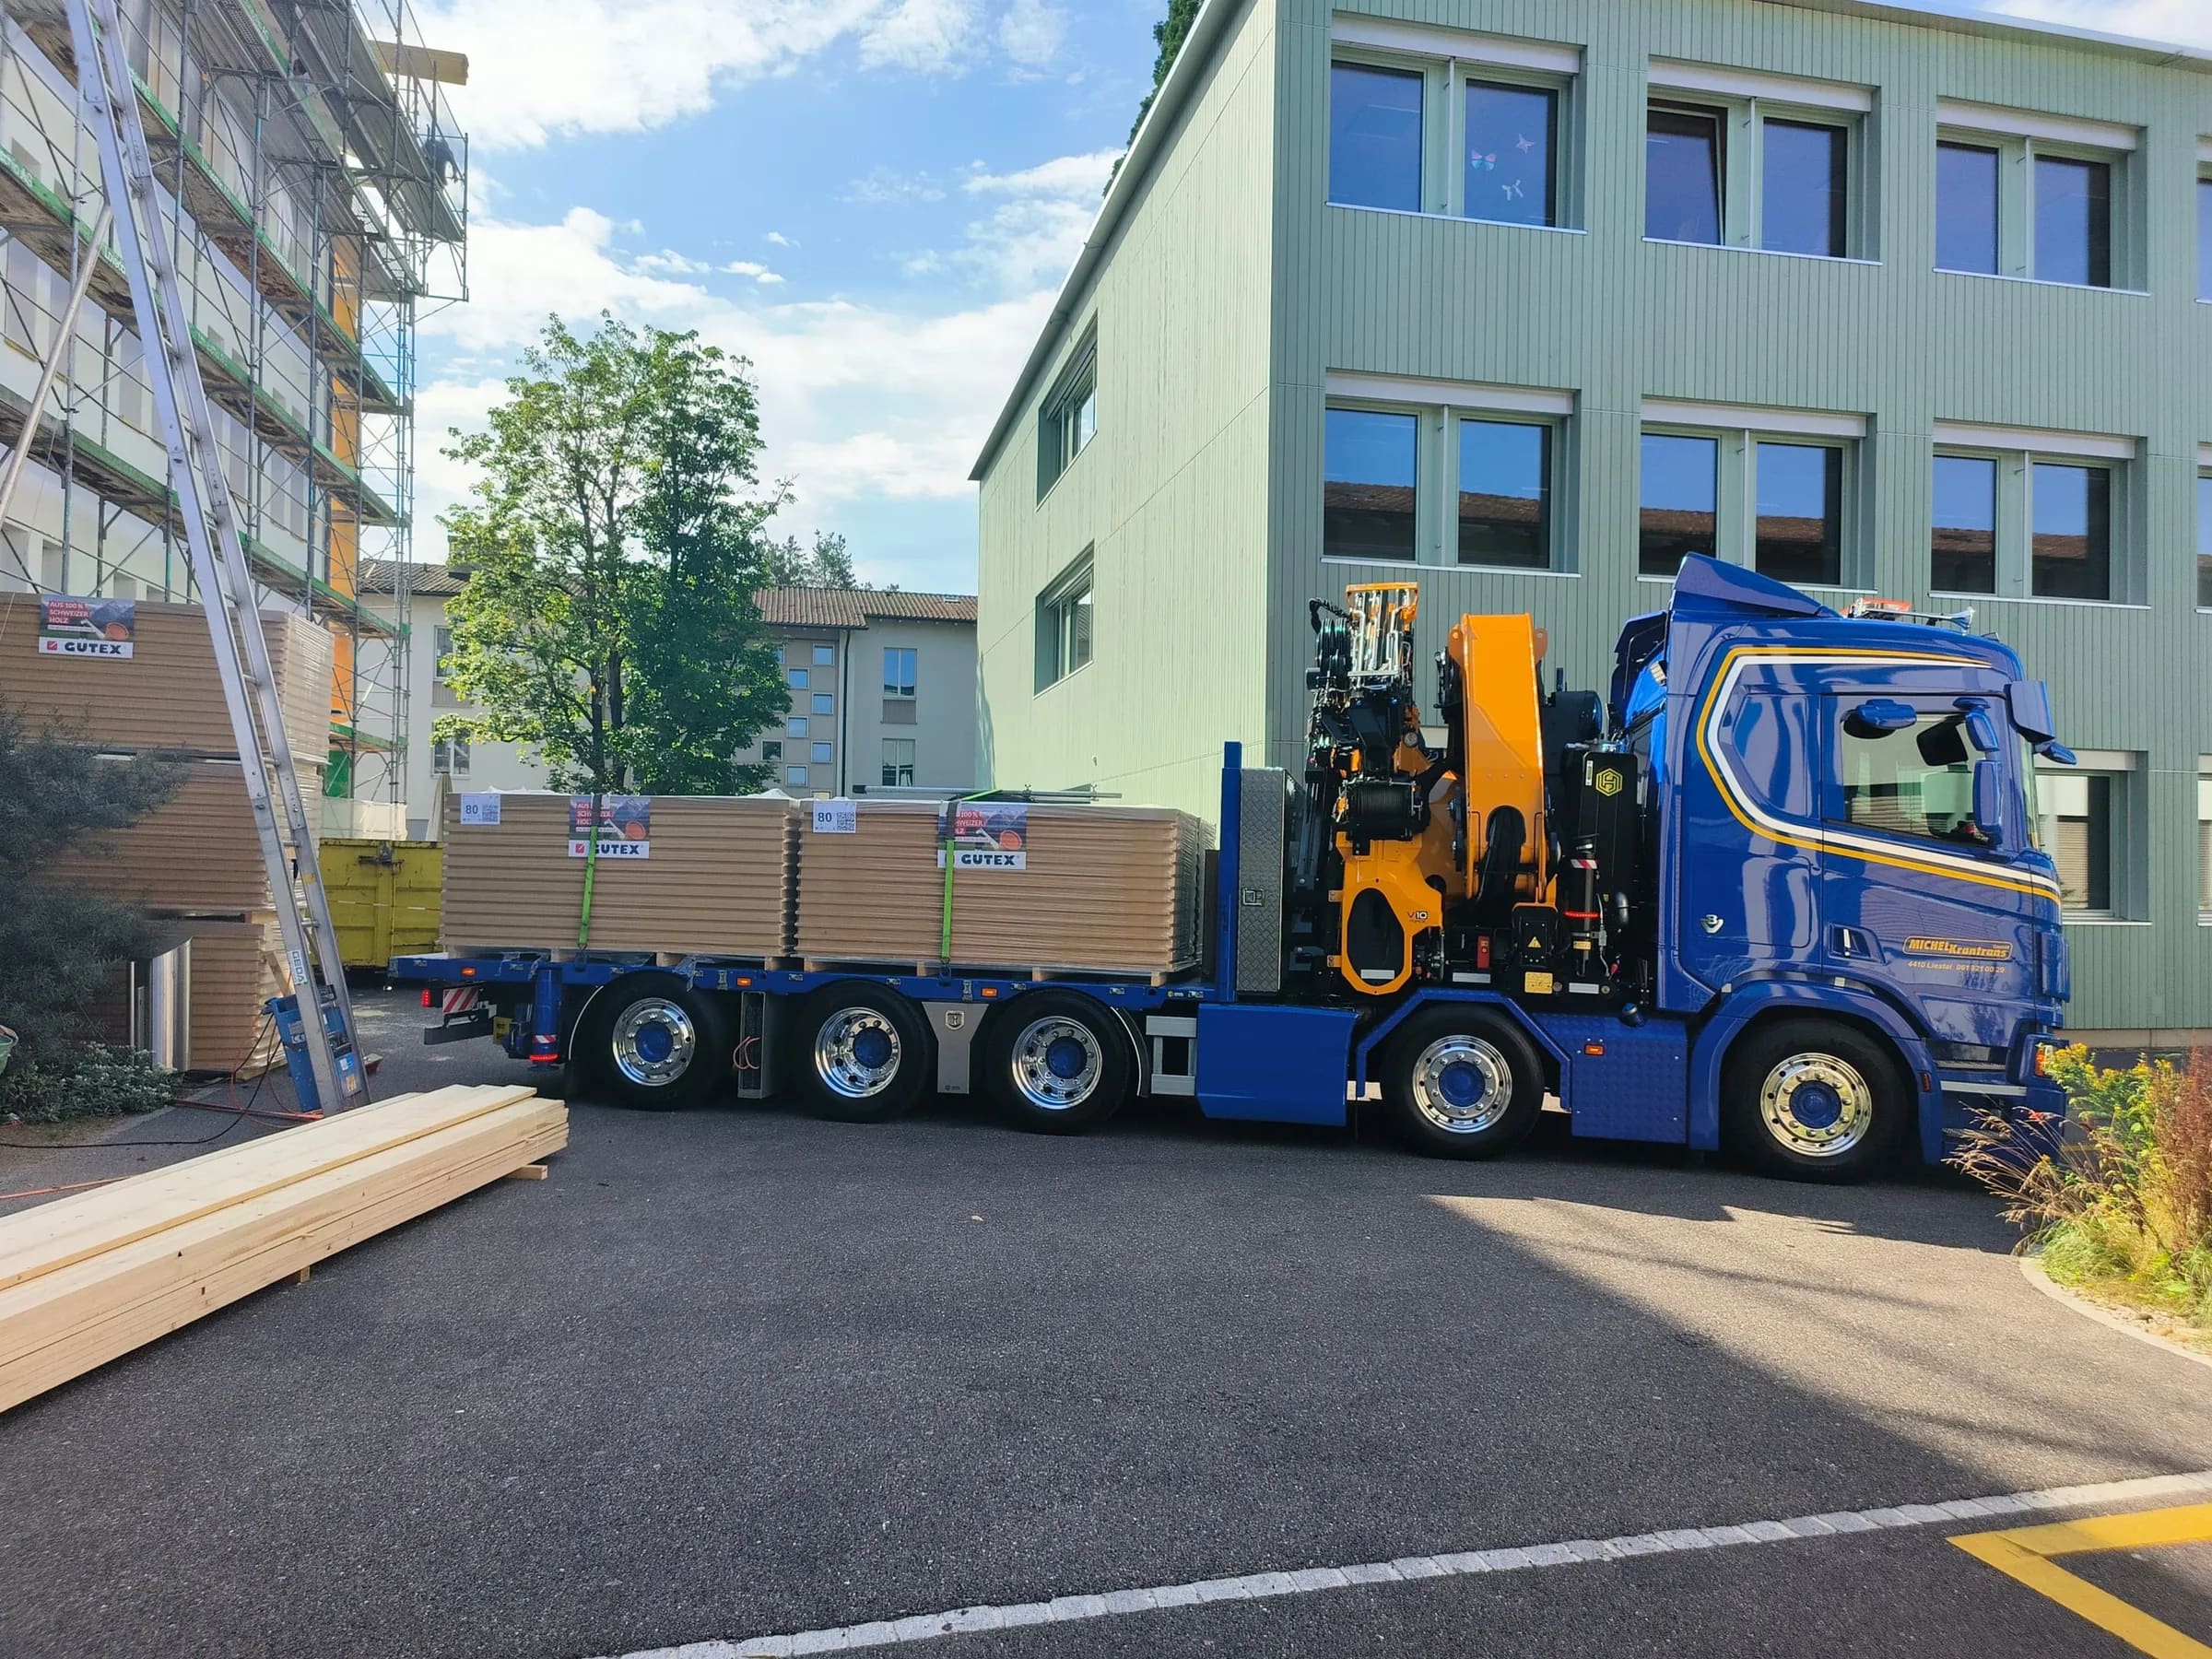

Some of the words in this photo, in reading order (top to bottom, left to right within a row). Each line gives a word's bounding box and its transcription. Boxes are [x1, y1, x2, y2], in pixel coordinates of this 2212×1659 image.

[49, 609, 89, 618] SCHWEIZER
[49, 617, 69, 625] HOLZ
[65, 641, 121, 654] GUTEX
[465, 804, 479, 815] 80
[818, 811, 833, 823] 80
[961, 853, 1015, 865] GUTEX
[1406, 910, 1429, 920] V10
[292, 950, 304, 982] GEDA
